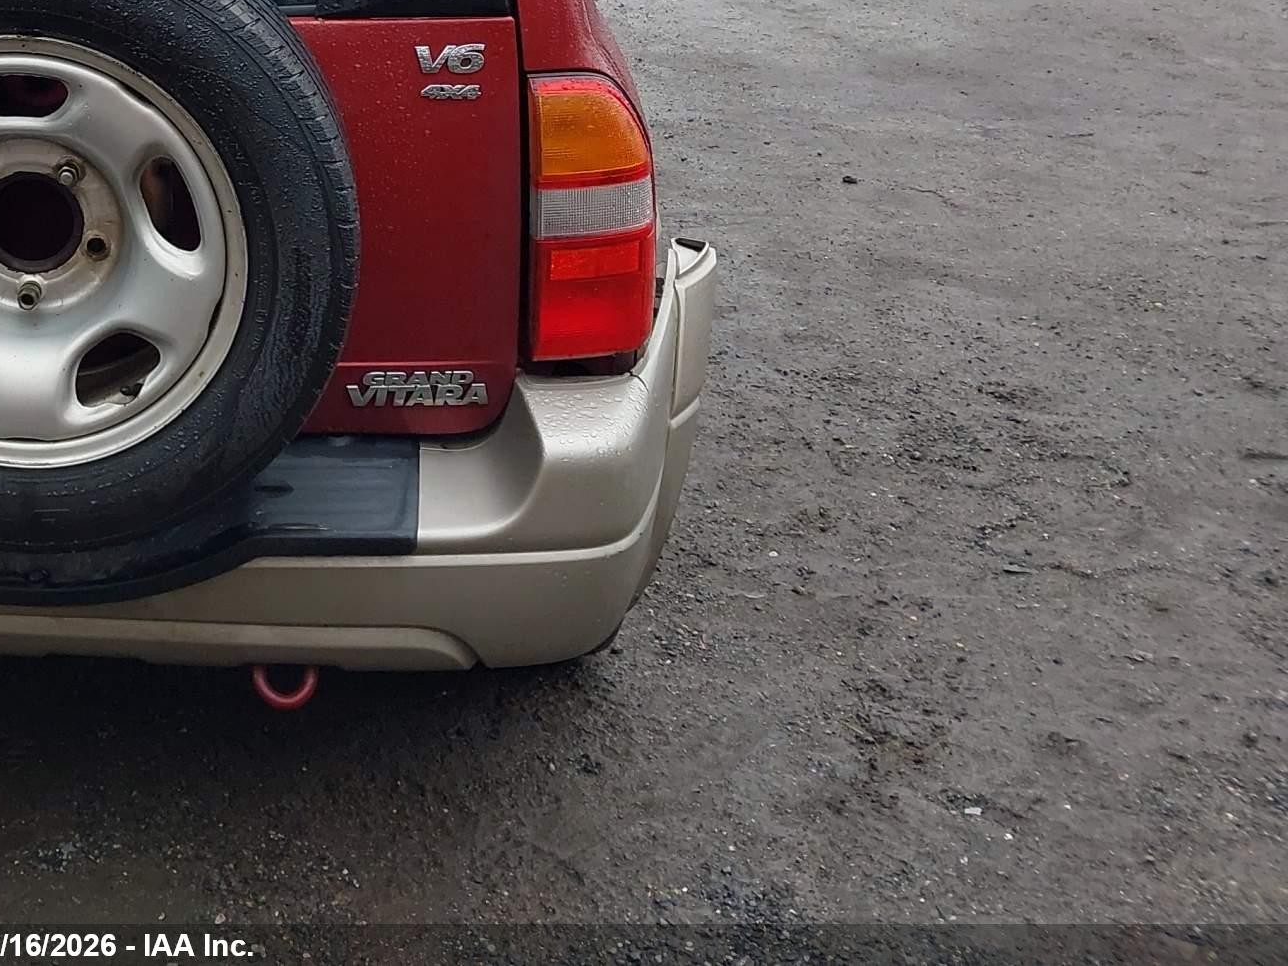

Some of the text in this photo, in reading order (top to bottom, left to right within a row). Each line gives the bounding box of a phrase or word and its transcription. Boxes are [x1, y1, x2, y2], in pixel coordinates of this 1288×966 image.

[414, 43, 485, 74] V6
[362, 370, 474, 385] GRAND
[345, 383, 489, 407] VITARA
